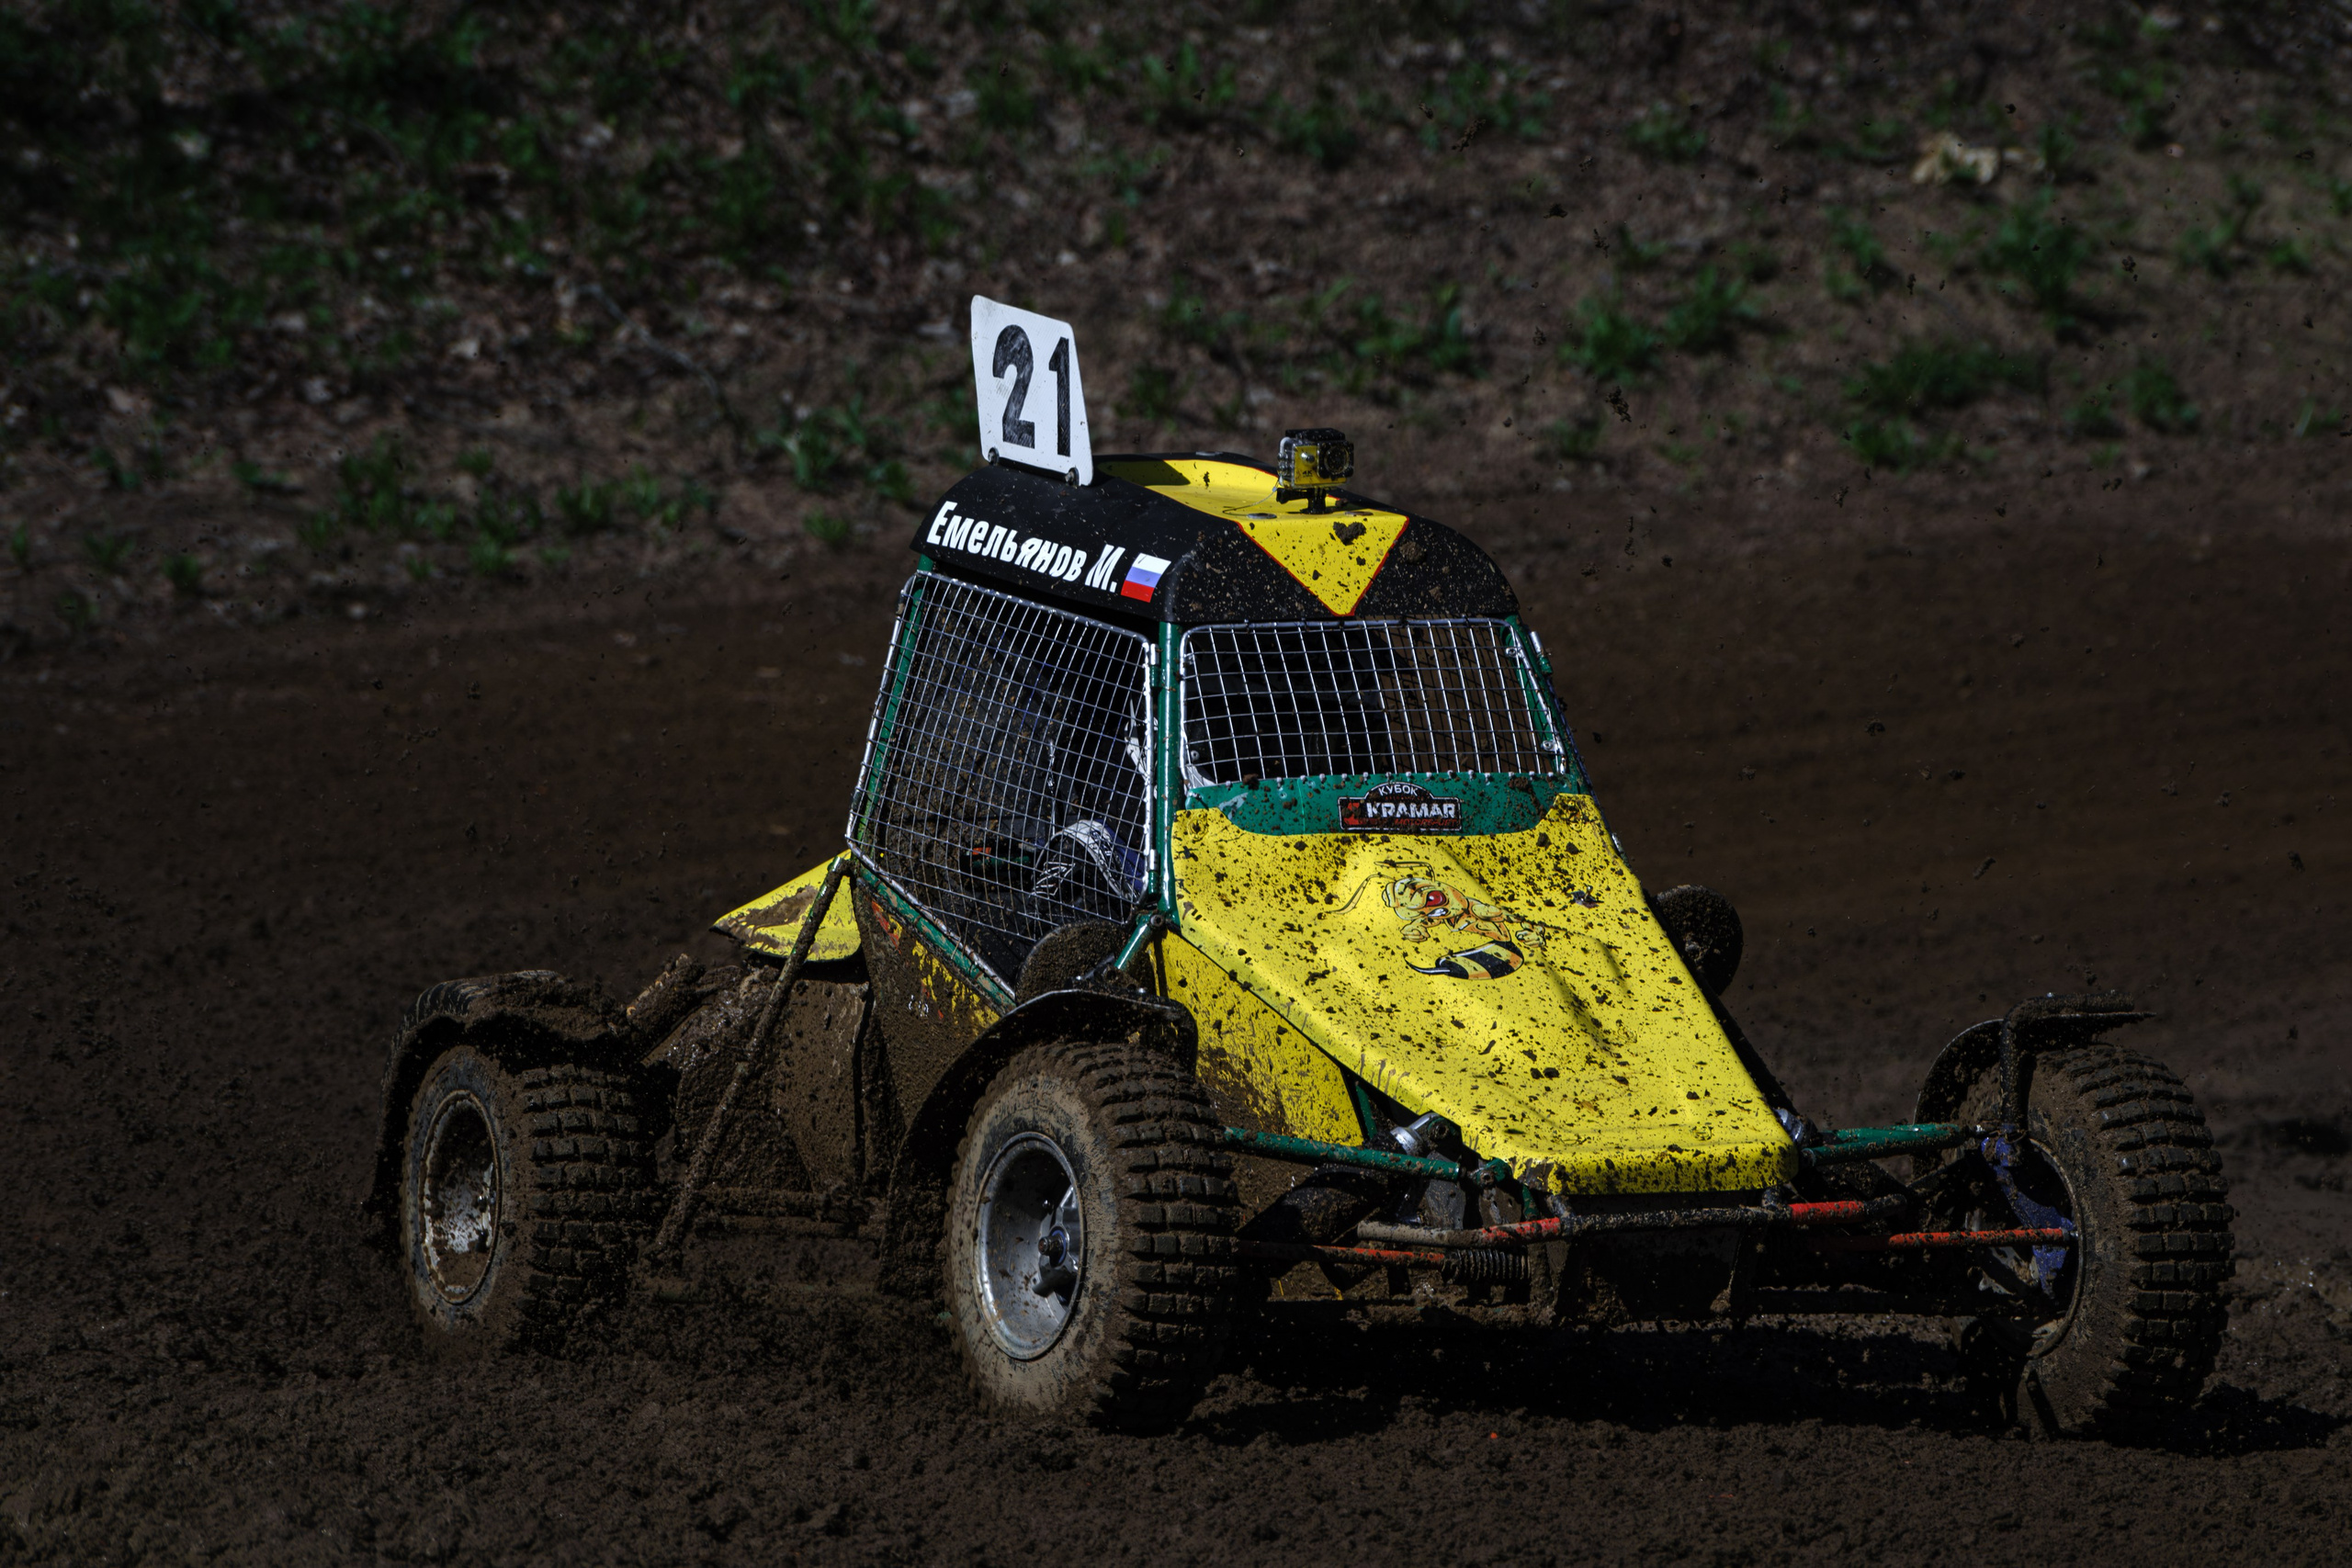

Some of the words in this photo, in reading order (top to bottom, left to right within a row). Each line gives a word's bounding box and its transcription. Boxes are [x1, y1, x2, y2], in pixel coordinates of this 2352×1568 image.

[992, 324, 1070, 457] 21
[926, 501, 1087, 581] Емельянов
[1084, 544, 1125, 592] М.
[1366, 802, 1455, 818] KRAMAR
[1378, 784, 1418, 796] КУБОК
